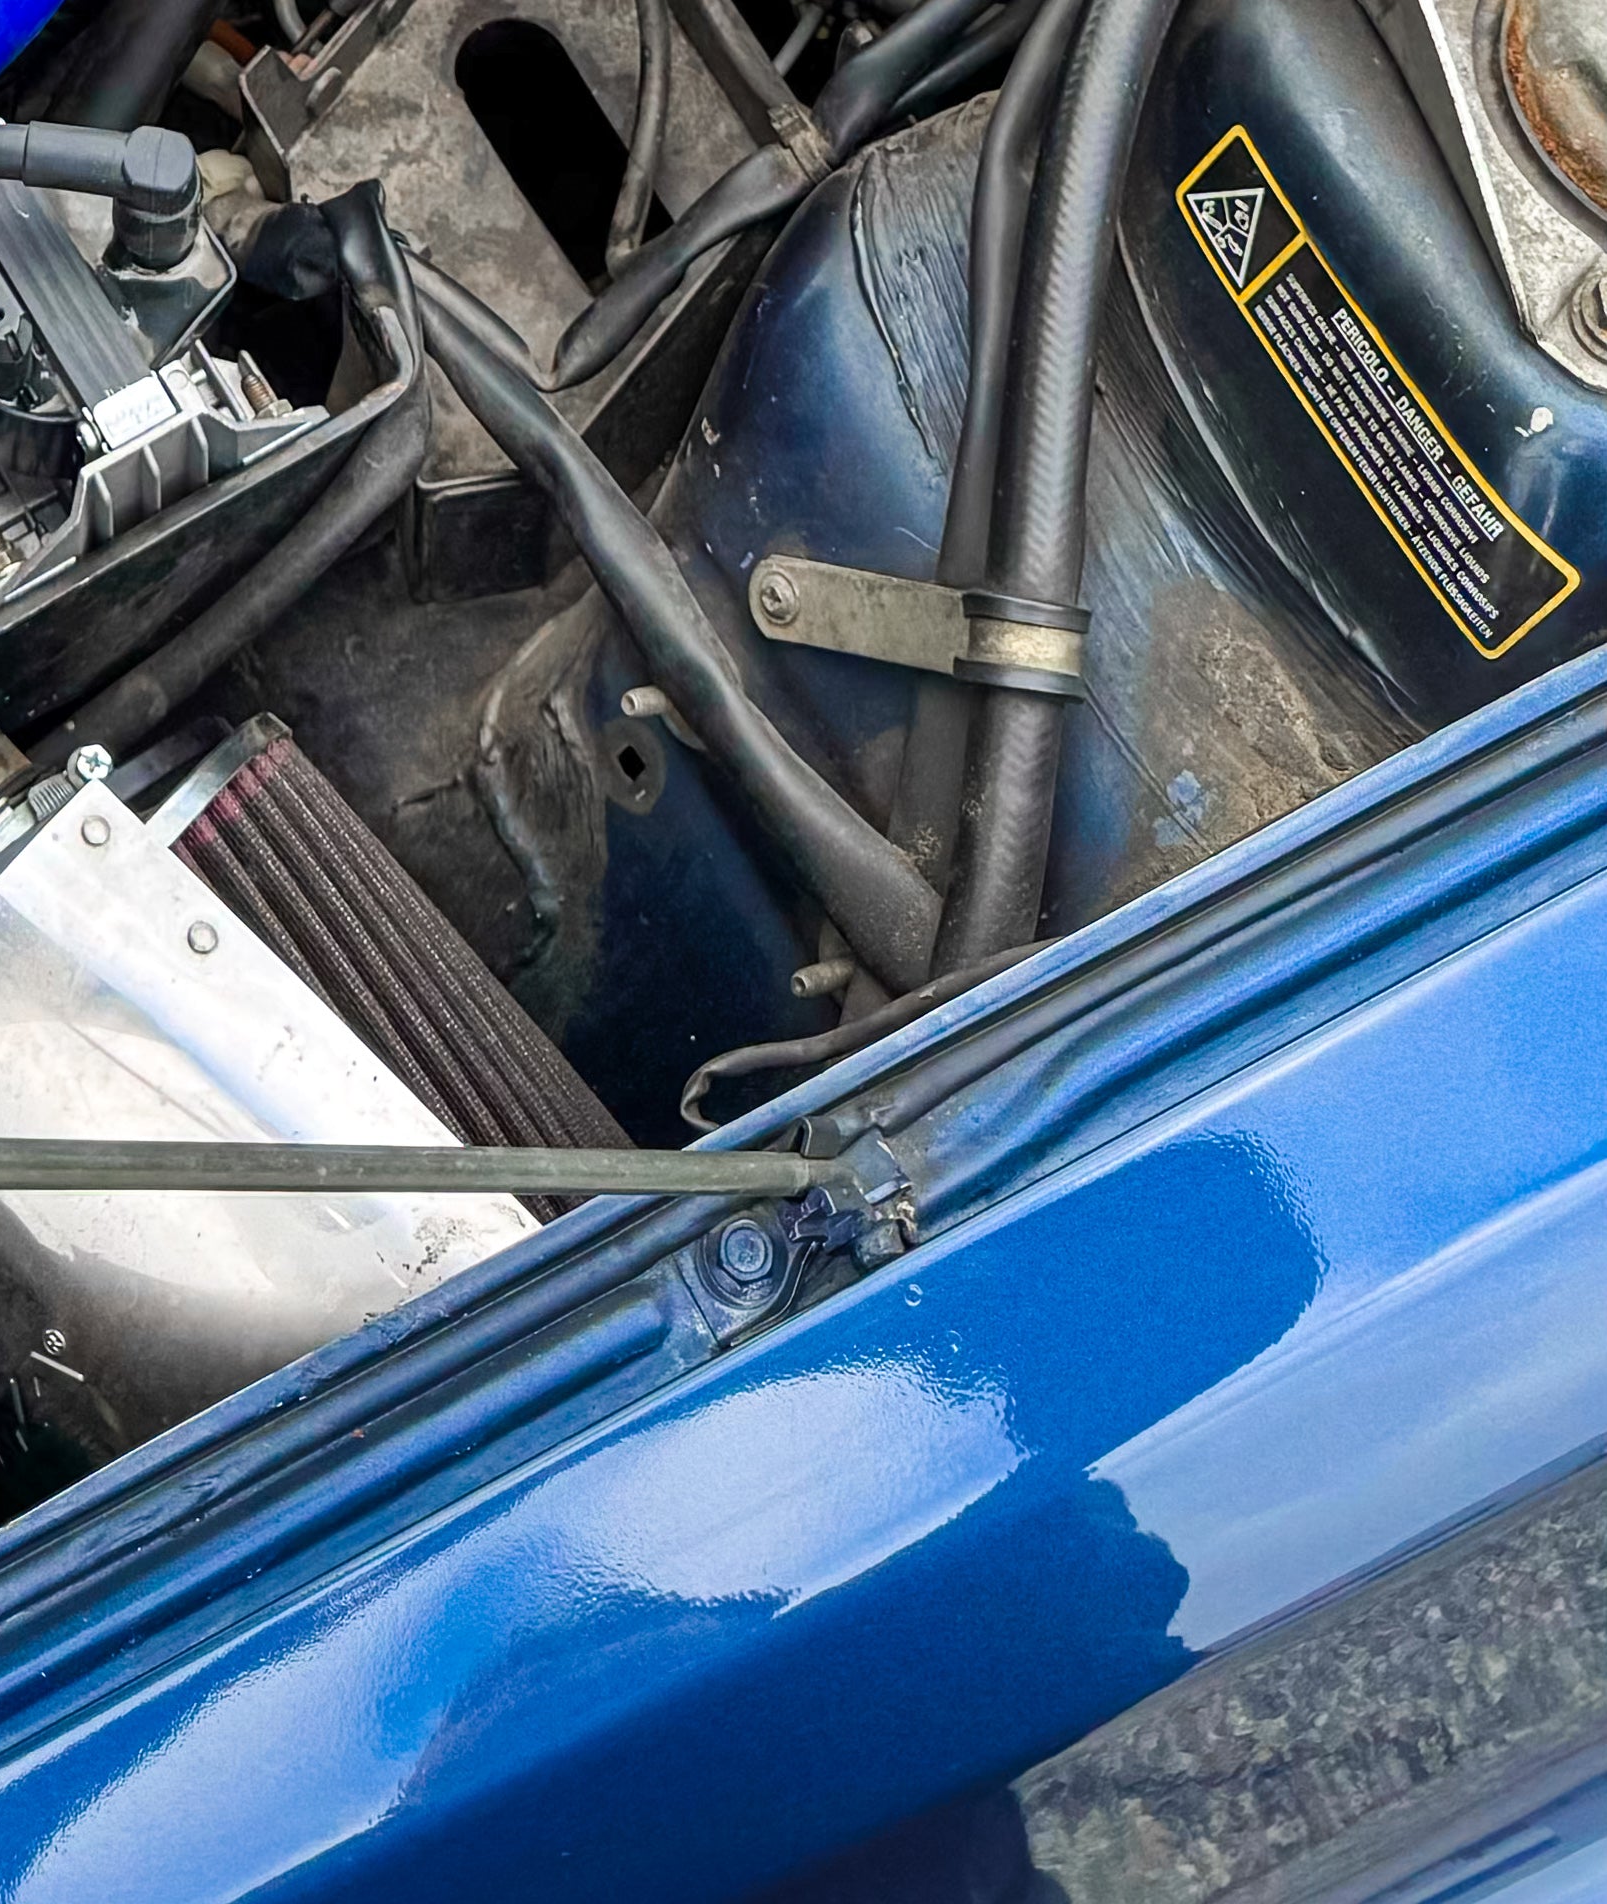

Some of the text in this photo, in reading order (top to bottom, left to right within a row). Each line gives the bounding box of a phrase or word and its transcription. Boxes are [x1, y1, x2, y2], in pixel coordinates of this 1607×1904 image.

[1333, 308, 1389, 382] PERICOLO
[1395, 395, 1444, 461] DANGER
[1452, 475, 1505, 539] GEFAHR
[1459, 547, 1490, 583] LIQUIDS
[1456, 571, 1499, 619] CORROSIFS
